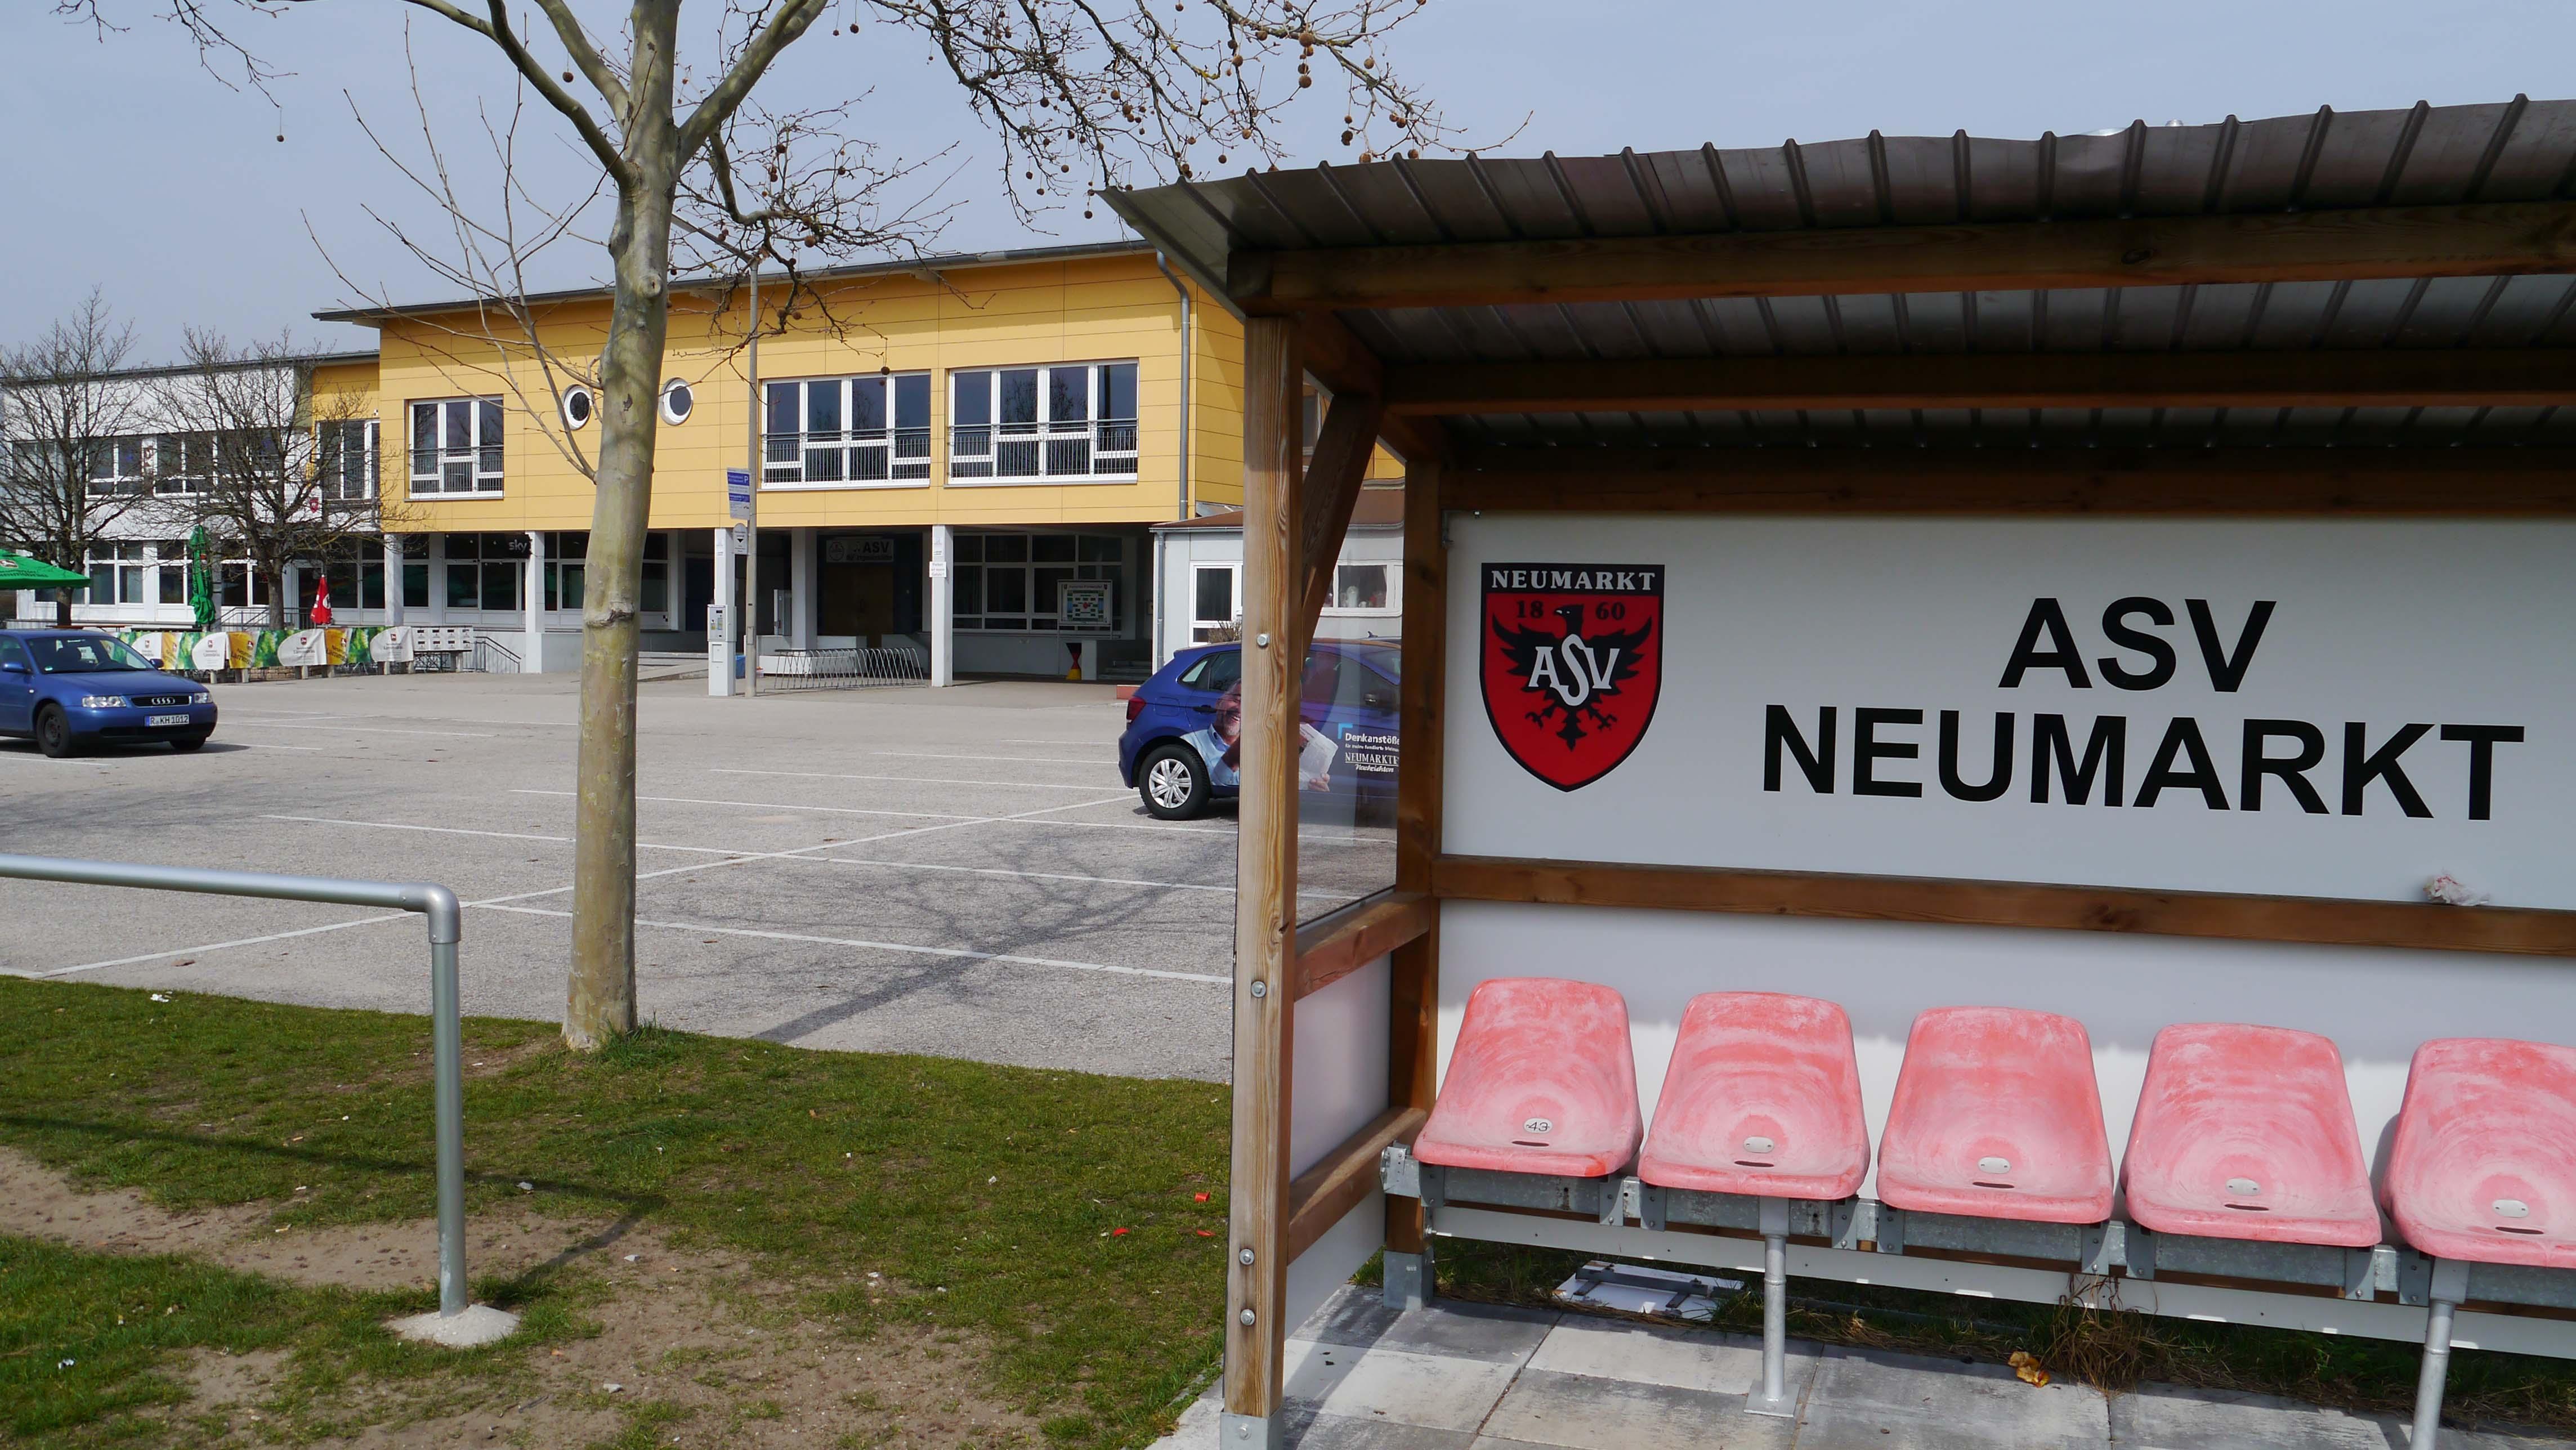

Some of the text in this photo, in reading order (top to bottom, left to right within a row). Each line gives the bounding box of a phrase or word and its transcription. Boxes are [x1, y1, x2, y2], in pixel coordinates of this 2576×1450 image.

[509, 539, 527, 552] sky
[864, 541, 889, 553] ASV
[1492, 570, 1656, 590] NEUMARKT
[1516, 600, 1625, 620] 18 60
[1998, 596, 2277, 692] ASV
[1528, 633, 1620, 706] ASV
[171, 715, 188, 724] 1012
[1354, 764, 1394, 773] Nachrichten
[1763, 704, 2525, 820] NEUMARKT
[1528, 1121, 1548, 1131] 43
